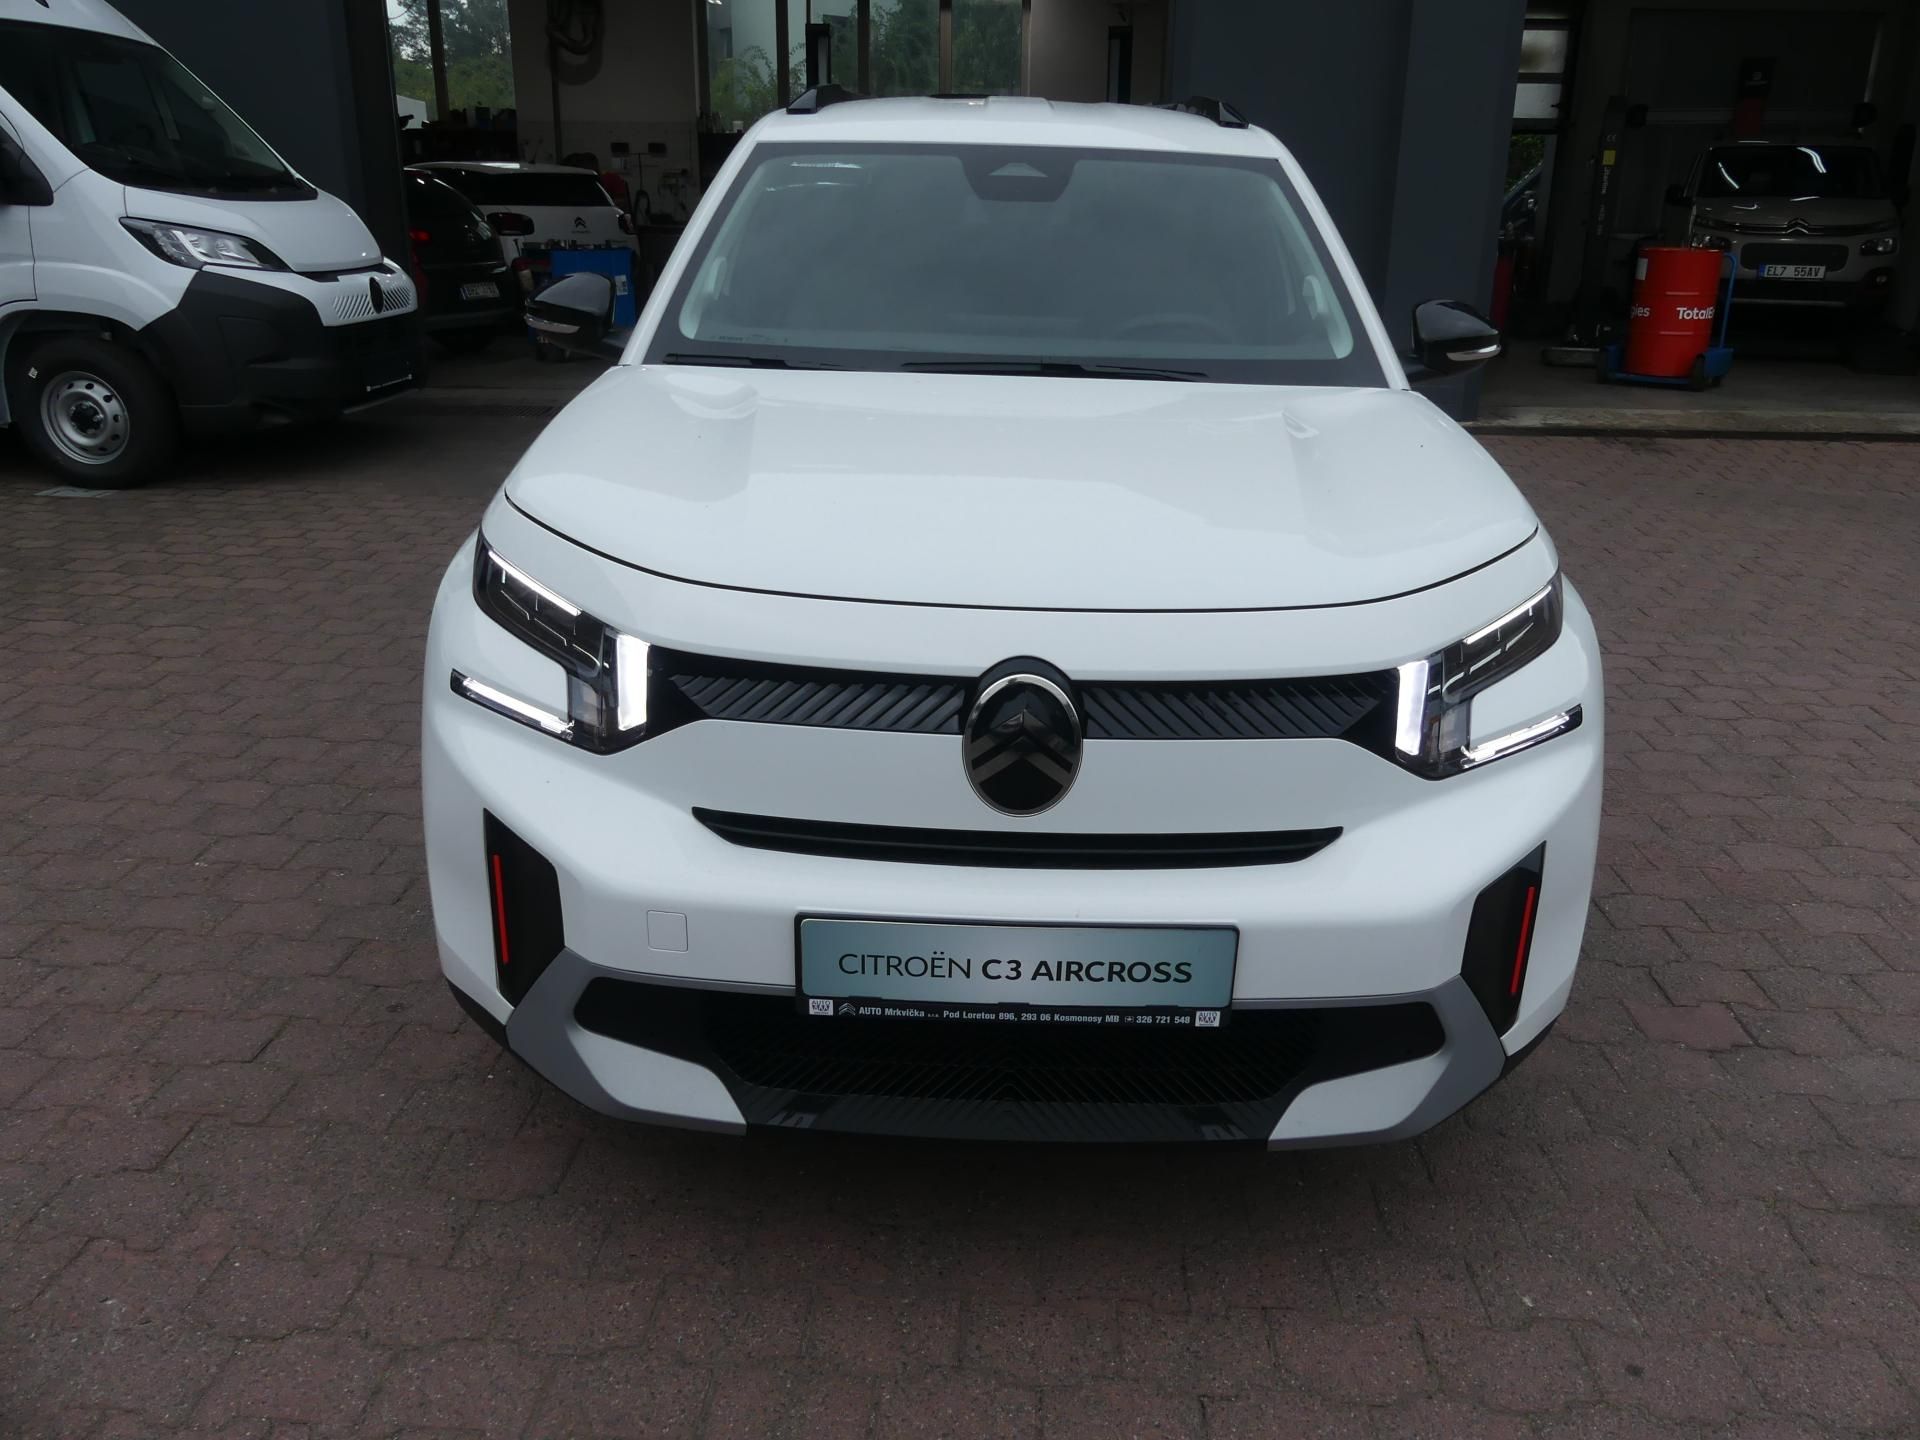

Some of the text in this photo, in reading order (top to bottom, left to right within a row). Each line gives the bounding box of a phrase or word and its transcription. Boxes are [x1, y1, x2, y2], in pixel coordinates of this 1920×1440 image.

[1767, 265, 1821, 277] EL7 55AV
[838, 951, 1193, 983] CITROËN C3 AIRCROSS
[858, 1006, 882, 1016] AUTO
[884, 1007, 925, 1018] Mrkvička
[943, 1010, 960, 1019] Pod
[962, 1011, 996, 1020] Loretou
[998, 1012, 1018, 1022] 896,
[1021, 1012, 1037, 1021] 293
[1040, 1013, 1051, 1021] 06
[1054, 1013, 1103, 1024] Kosmonosy
[1105, 1014, 1120, 1023] MB
[1136, 1015, 1153, 1024] 326
[1155, 1015, 1171, 1024] 721
[1174, 1016, 1191, 1025] 548
